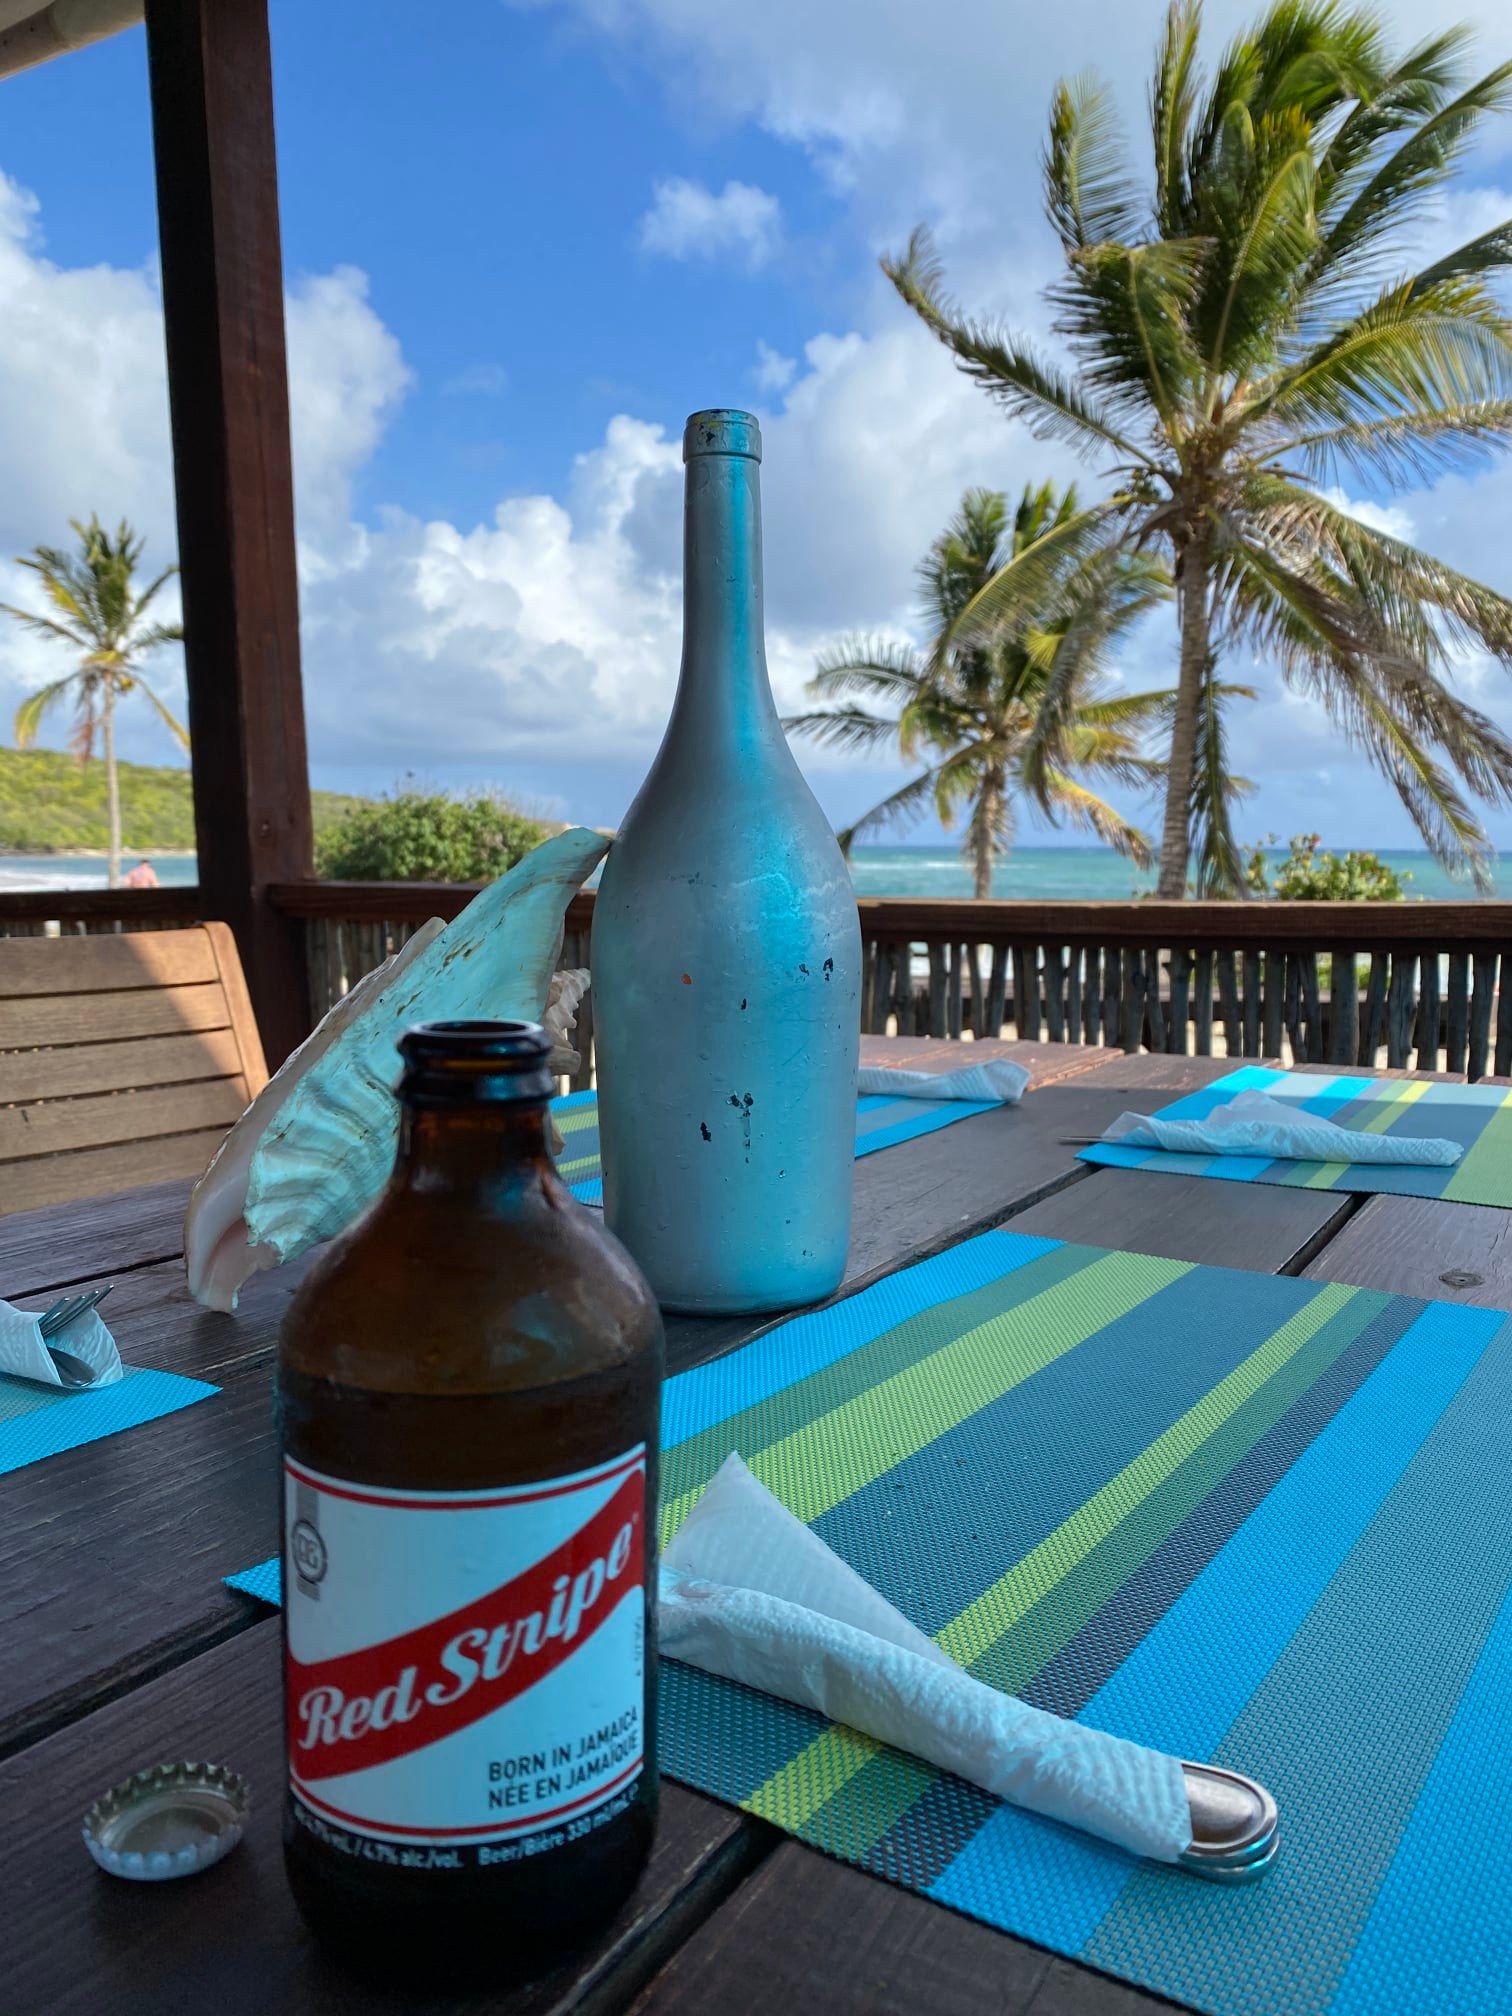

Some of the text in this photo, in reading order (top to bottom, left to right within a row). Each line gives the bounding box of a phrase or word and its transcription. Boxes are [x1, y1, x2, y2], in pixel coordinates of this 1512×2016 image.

[298, 1666, 421, 1750] Red
[426, 1522, 632, 1705] Stripe
[488, 1705, 638, 1783] BORN IN JAMAICA
[488, 1781, 530, 1809] NÉE
[535, 1774, 561, 1799] EN
